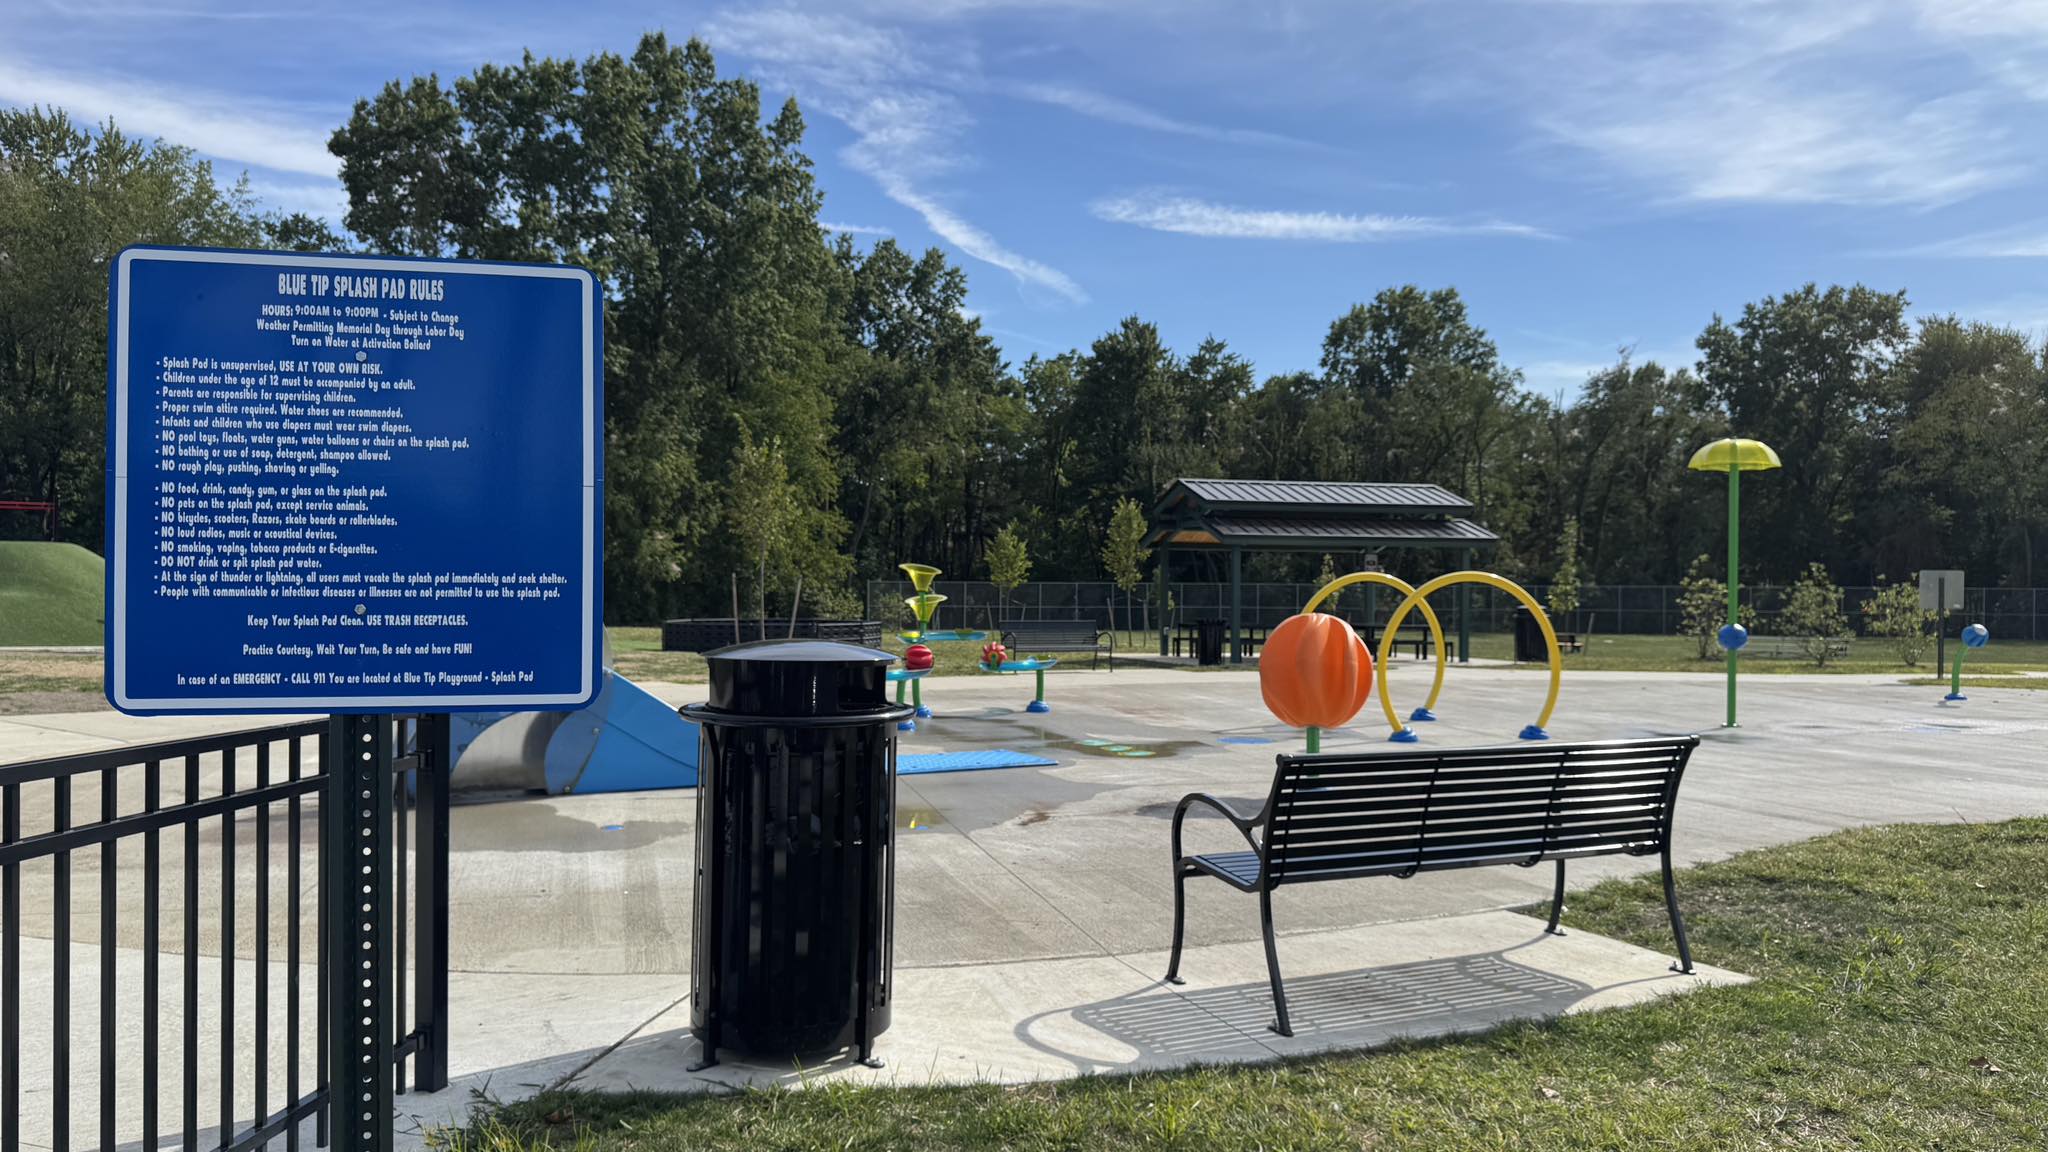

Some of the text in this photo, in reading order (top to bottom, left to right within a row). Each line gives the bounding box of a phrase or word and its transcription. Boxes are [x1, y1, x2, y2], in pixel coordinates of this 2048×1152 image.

[277, 273, 444, 302] BLUE TIP SPLASH PAD RULES
[261, 304, 459, 326] HOURS: 9:00AM to 9:00PM Subject to Change
[255, 318, 465, 341] Weather Permitting Memorial Day through Labor Day
[290, 334, 431, 351] Turn on Water at Activation Bollard
[162, 356, 383, 375] Splash Pad is unsupervised, USE AT YOUR OWN RISK.
[162, 371, 416, 392] Children under the age of 12 must be accompanied by an adult.
[161, 386, 356, 405] Parents are responsible for supervising children.
[161, 401, 404, 419] Proper swim attire required. Water shoes are recommended.
[161, 415, 412, 435] Infants and children who use diapers must wear swim diapers.
[161, 444, 391, 463] NO bathing or use of soap, detergent, shampoo allowed.
[161, 459, 340, 478] NO rough play, pushing, shoving or yelling.
[160, 511, 398, 527] NO bicycles, scooters, Razors, skate boards or rollerblades.
[160, 526, 338, 540] NO loud radios, music or acoustical devices.
[160, 541, 378, 557] NO smoking, vaping, tobacco products or E-cigarettes.
[160, 555, 322, 571] DO NOT drink or spit splash pad water.
[247, 614, 469, 629] Keep Your Splash Pad Clean. USE TRASH RECEPTACLES.
[242, 643, 473, 658] Practice Courtesy, Wait Your Turn, Be safe and have FUN!
[177, 671, 534, 686] In case of an EMERGENCY CALL 911 You are located at Blue Tip Playground Splash Pad
